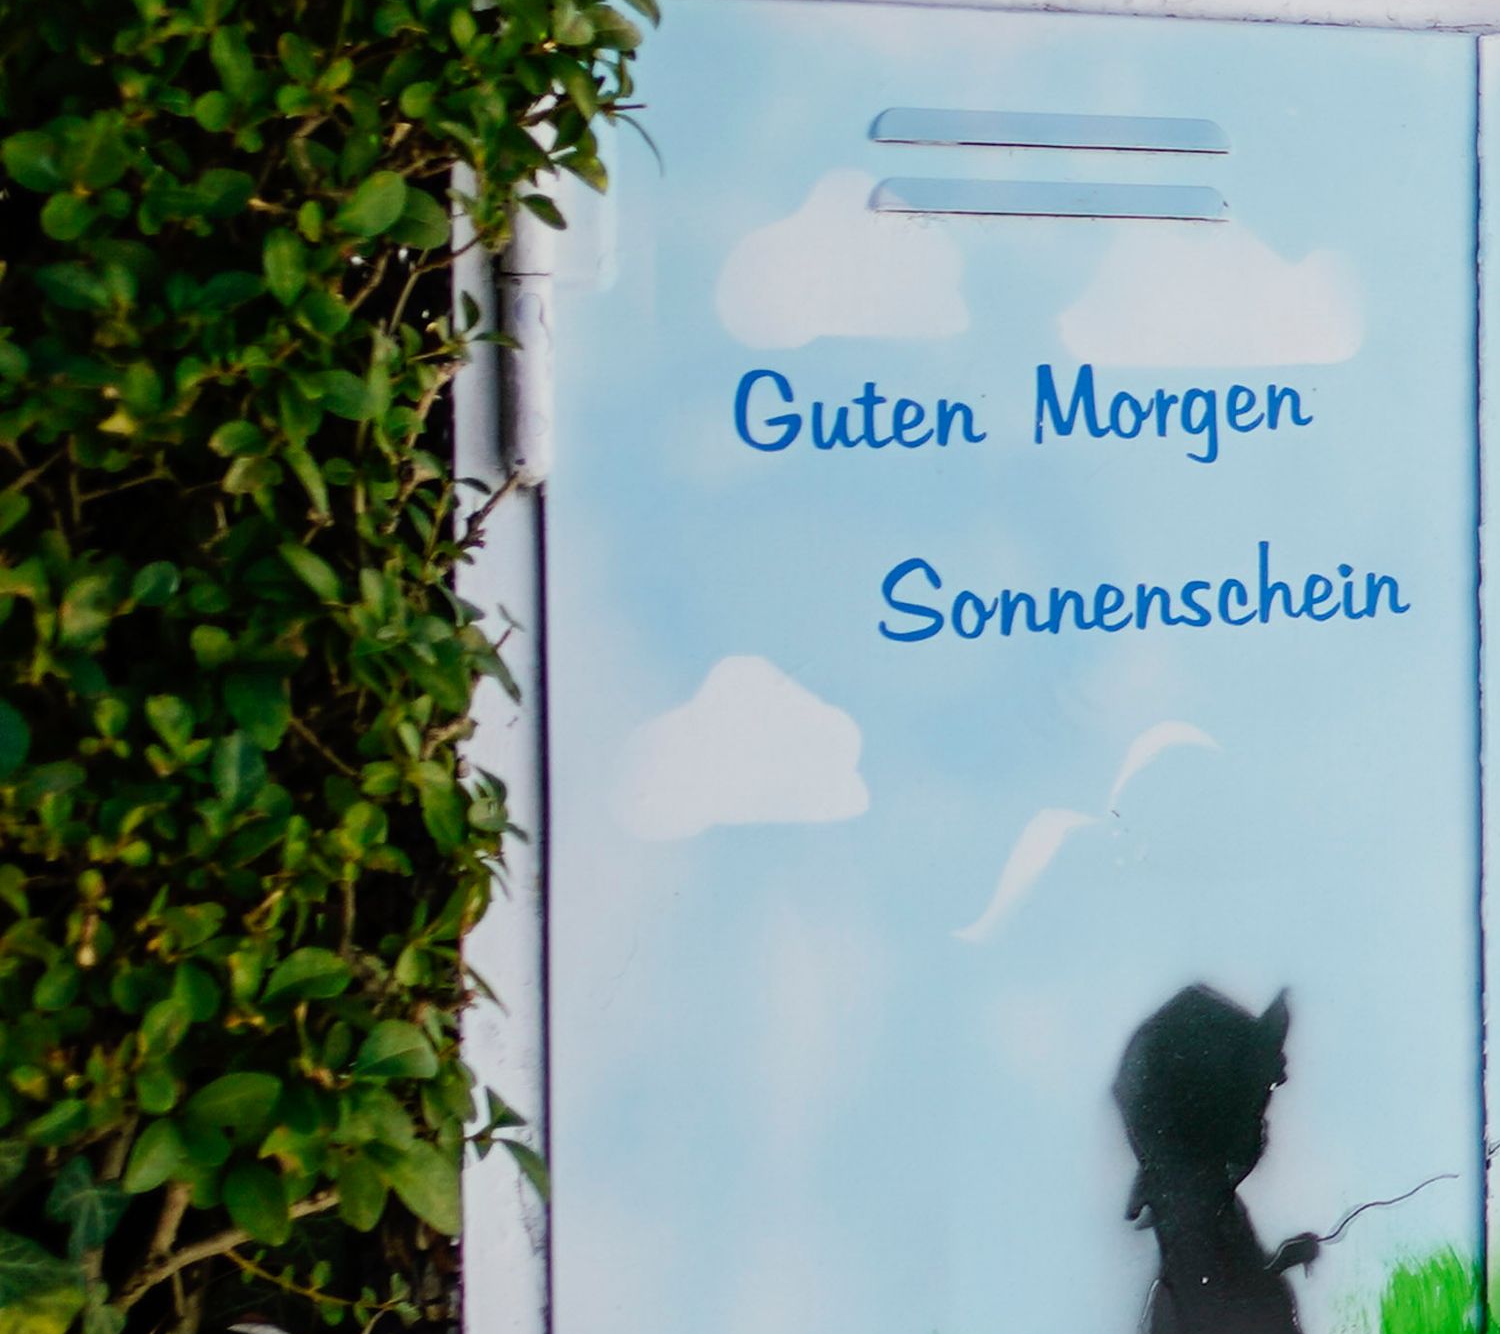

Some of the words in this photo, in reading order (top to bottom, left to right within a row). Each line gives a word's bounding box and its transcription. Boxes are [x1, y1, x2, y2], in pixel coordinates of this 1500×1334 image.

[733, 368, 988, 452] Guten
[1034, 363, 1314, 464] Morgen
[878, 540, 1411, 643] Sonnenschein
